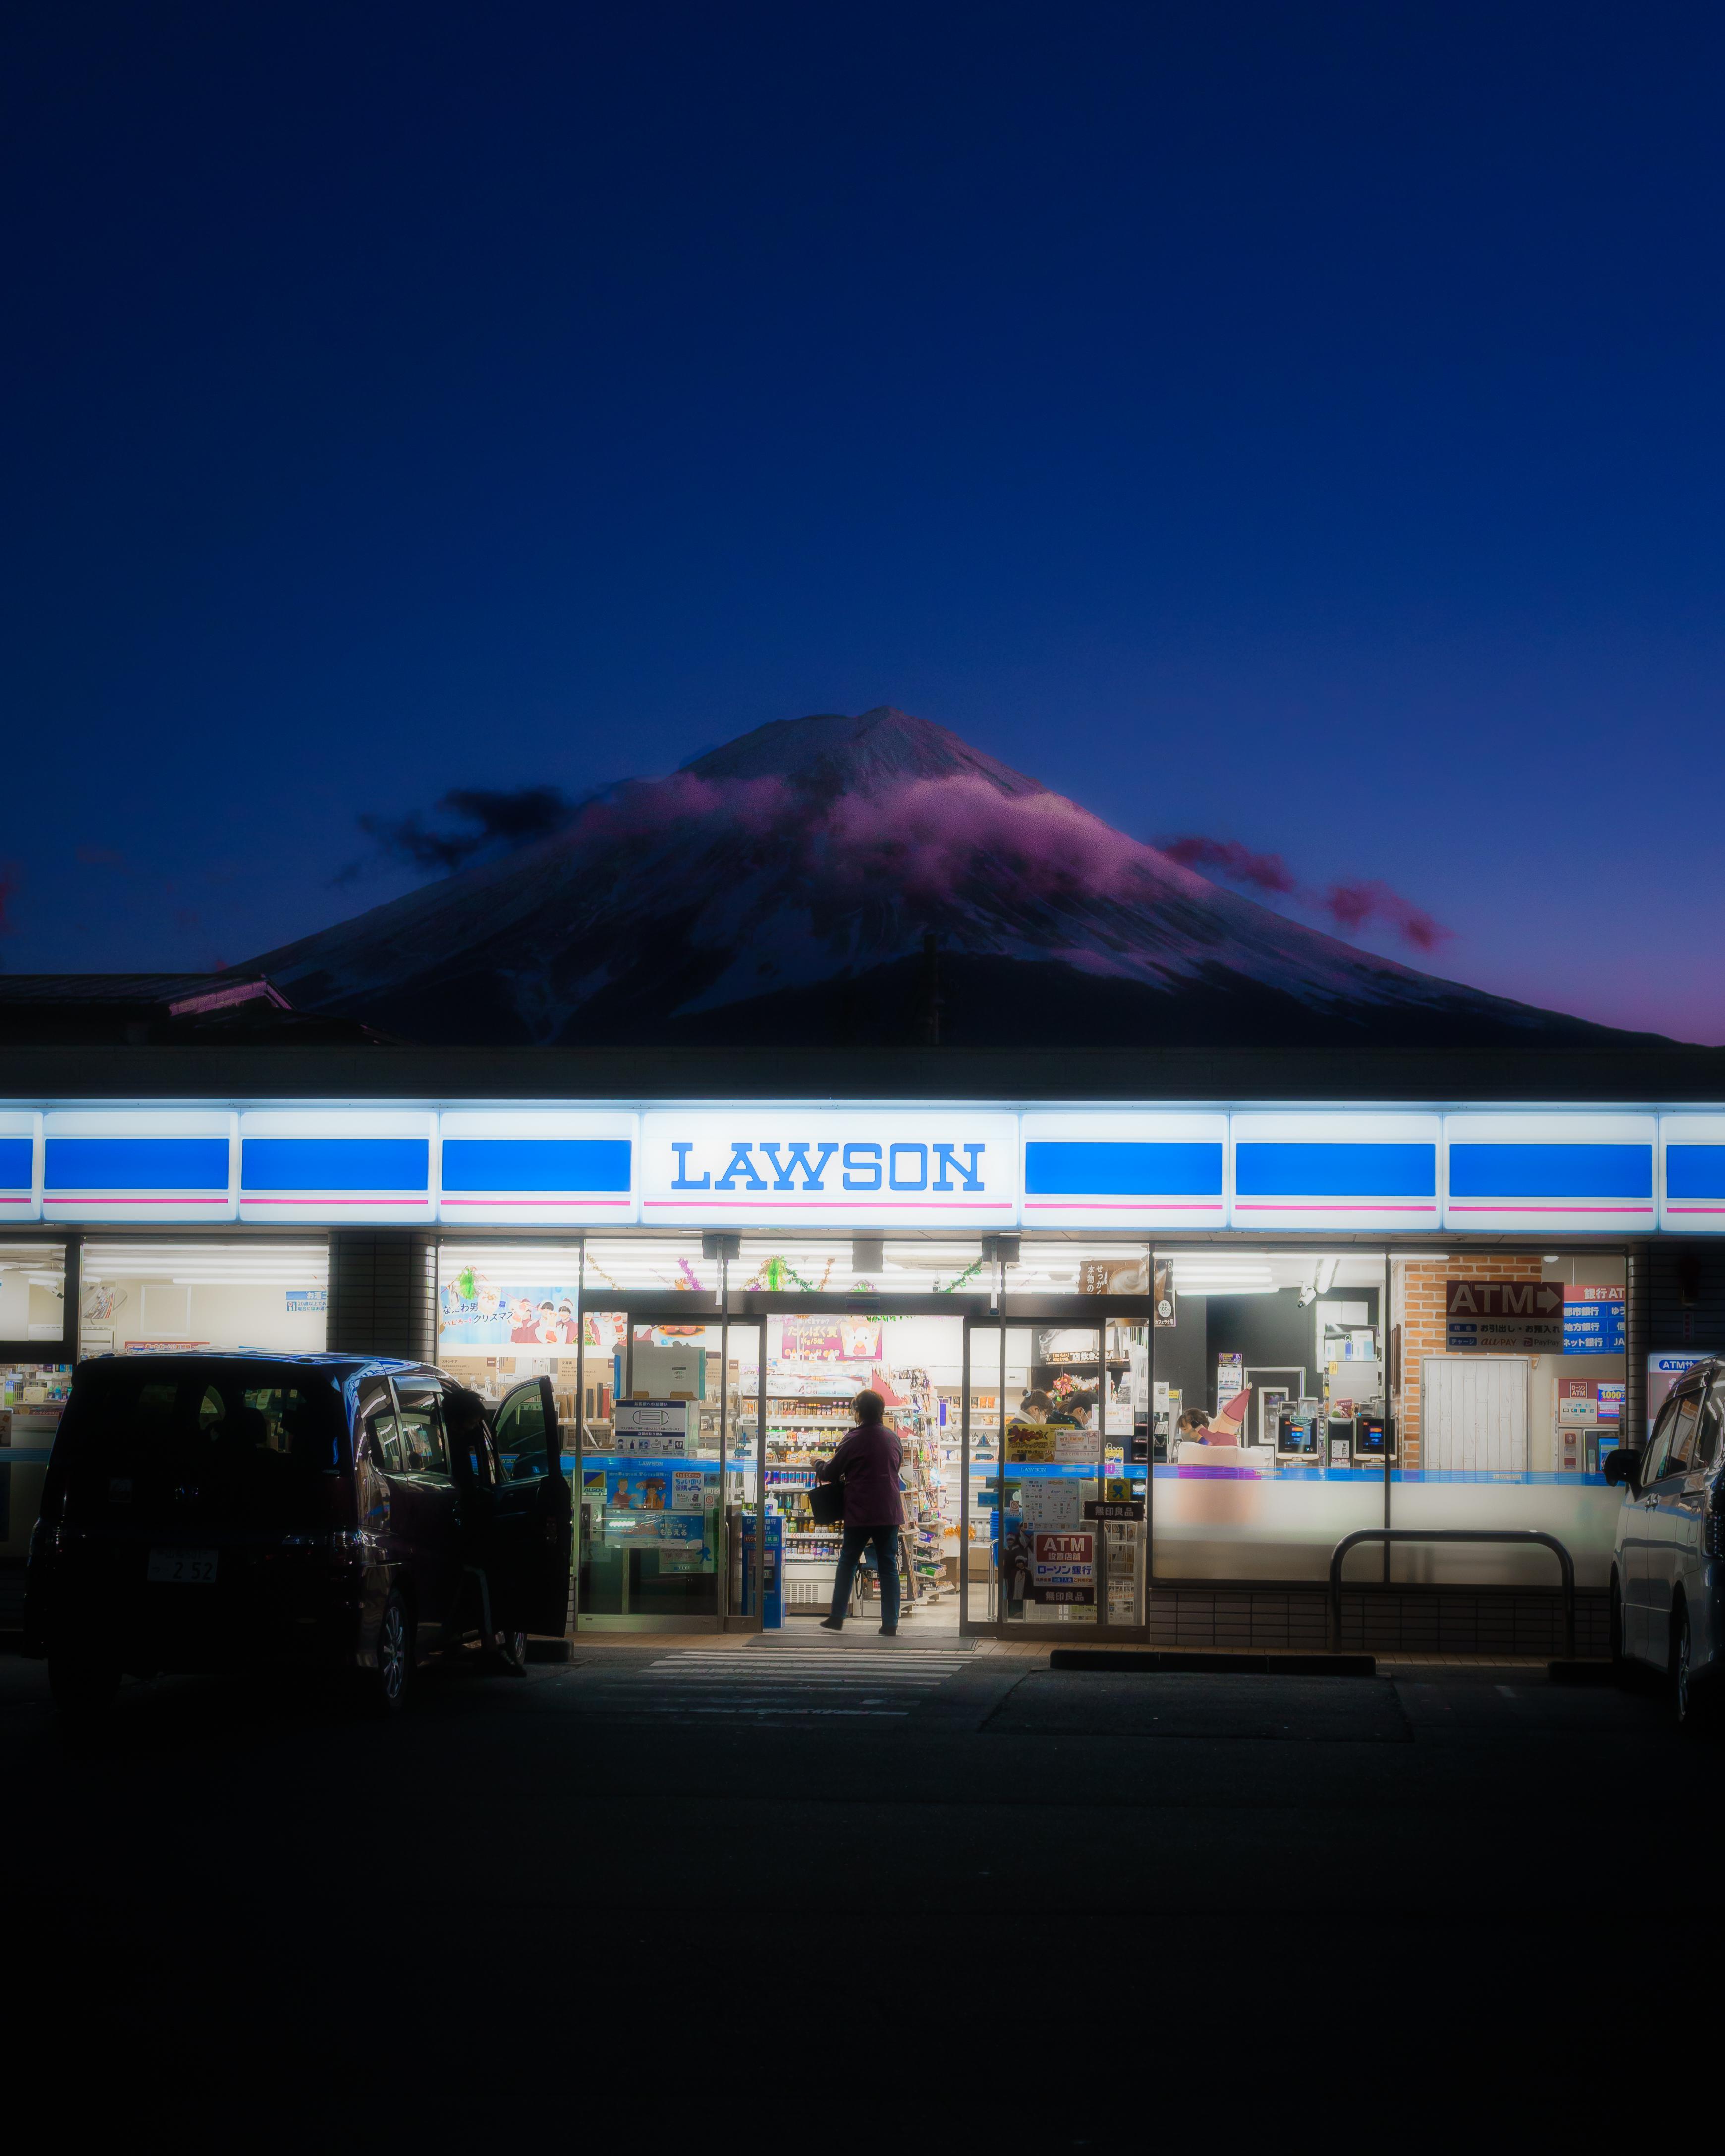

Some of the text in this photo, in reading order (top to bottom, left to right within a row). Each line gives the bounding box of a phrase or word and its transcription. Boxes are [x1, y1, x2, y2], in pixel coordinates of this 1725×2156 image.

[672, 1143, 985, 1191] LAWSON
[1449, 1284, 1534, 1314] ATM
[1564, 1307, 1599, 1316] 都市銀行
[1480, 1324, 1560, 1333] お引出し・お預入れ
[1564, 1323, 1599, 1331] 地方銀行
[1534, 1339, 1560, 1348] PayPay
[1564, 1338, 1603, 1347] ネット銀行
[1095, 1506, 1134, 1517] 無印良品
[1043, 1538, 1085, 1552] ATM
[1037, 1565, 1092, 1575] ローソン銀行
[1045, 1591, 1084, 1601] 無印良品
